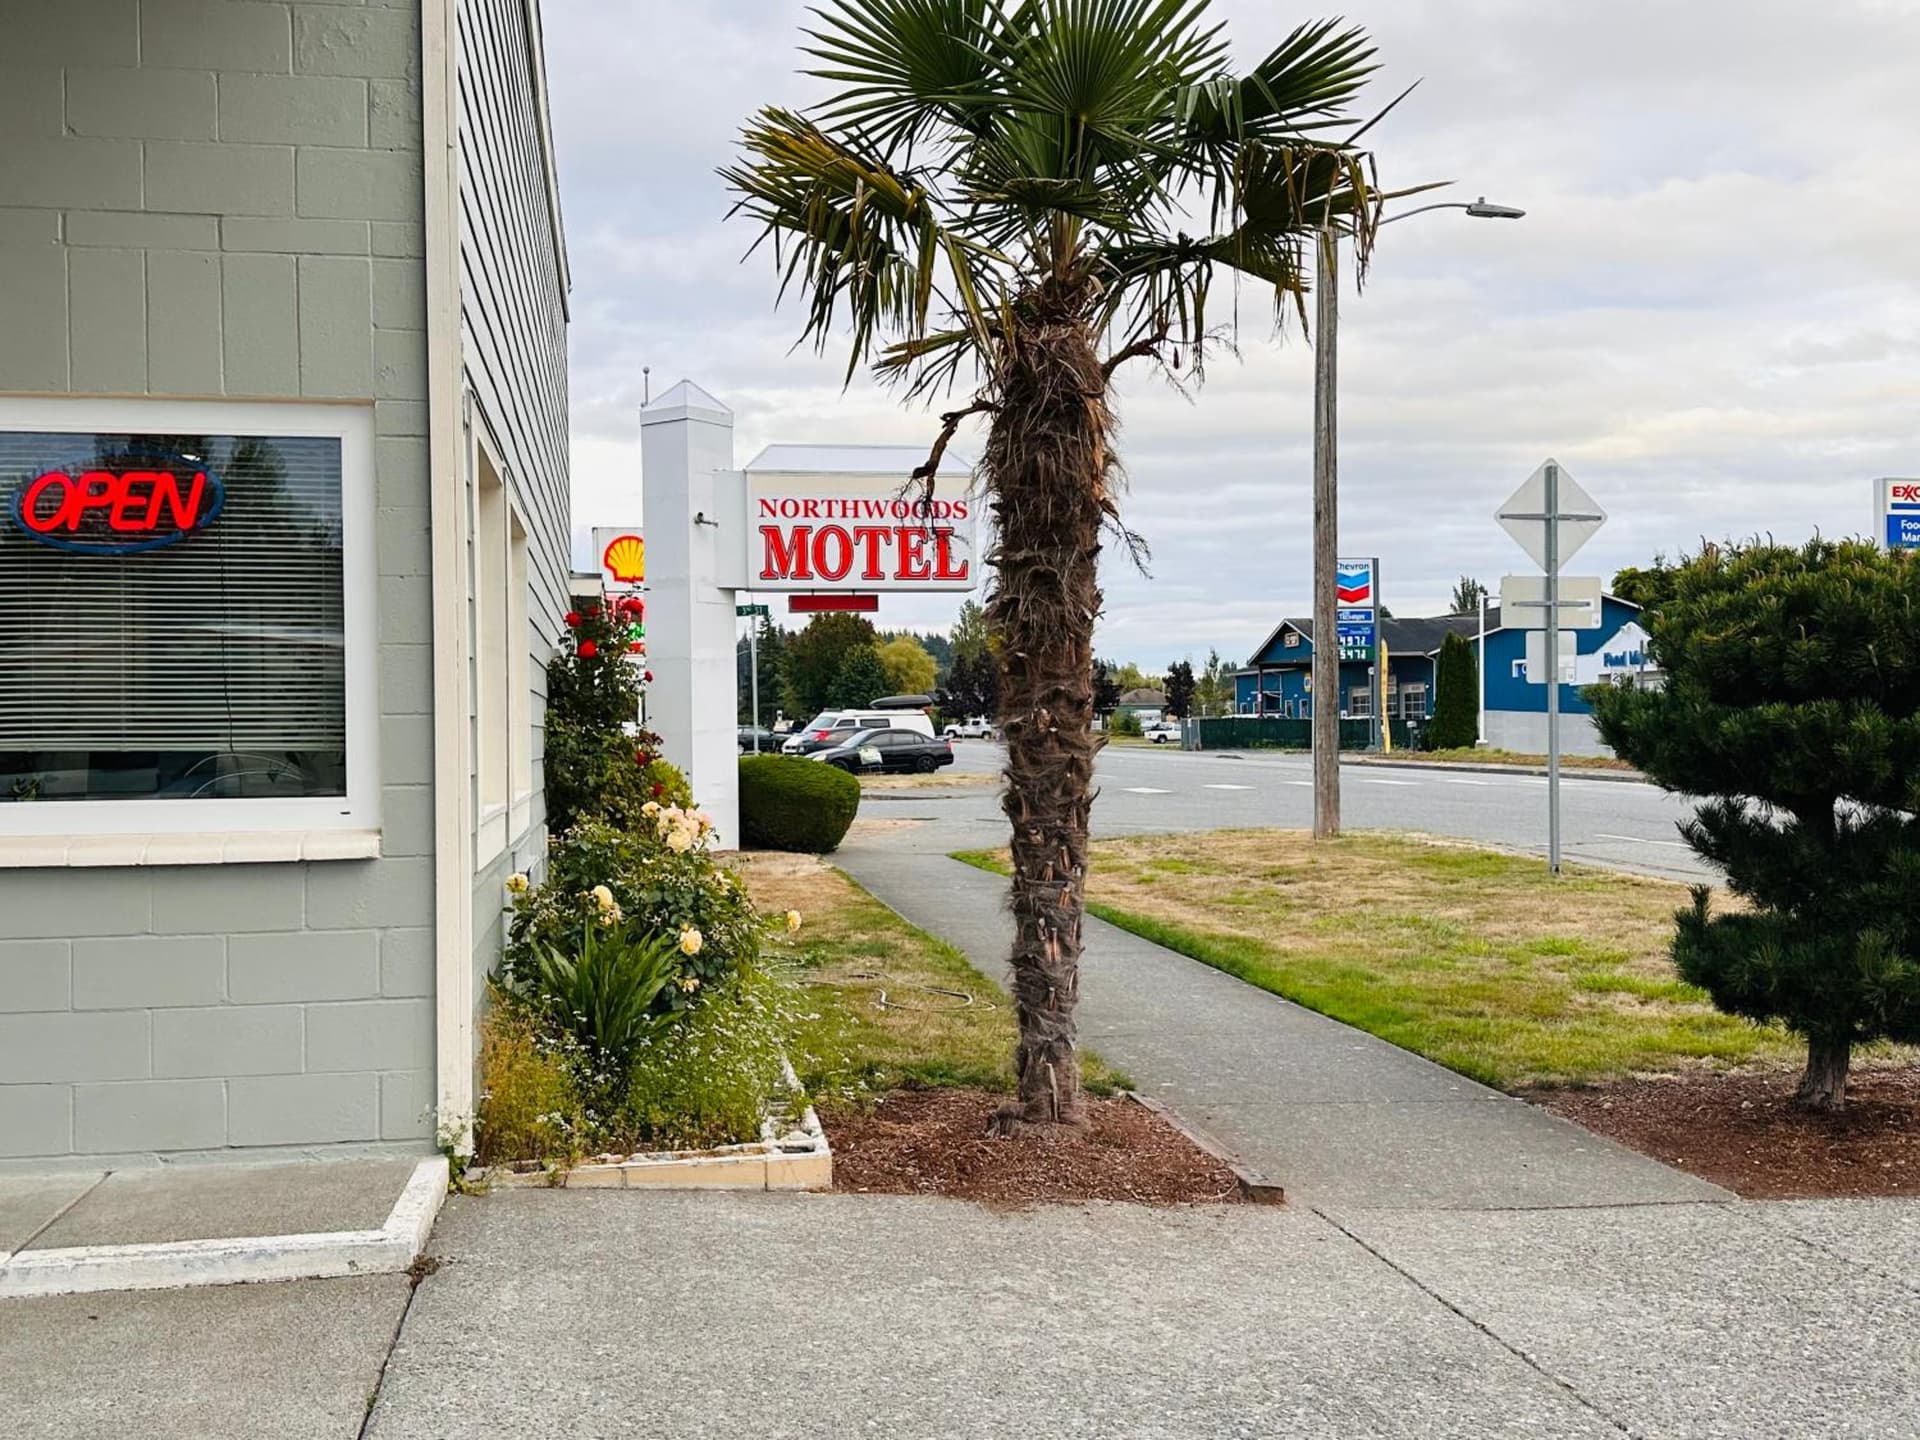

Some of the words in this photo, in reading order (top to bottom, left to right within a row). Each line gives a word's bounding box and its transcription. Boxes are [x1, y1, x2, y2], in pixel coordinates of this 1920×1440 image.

[22, 470, 206, 532] OPEN
[759, 498, 968, 520] NORTHWOODS
[1901, 519, 1920, 530] Foo
[758, 524, 969, 581] MOTEL
[1338, 563, 1369, 571] hevron
